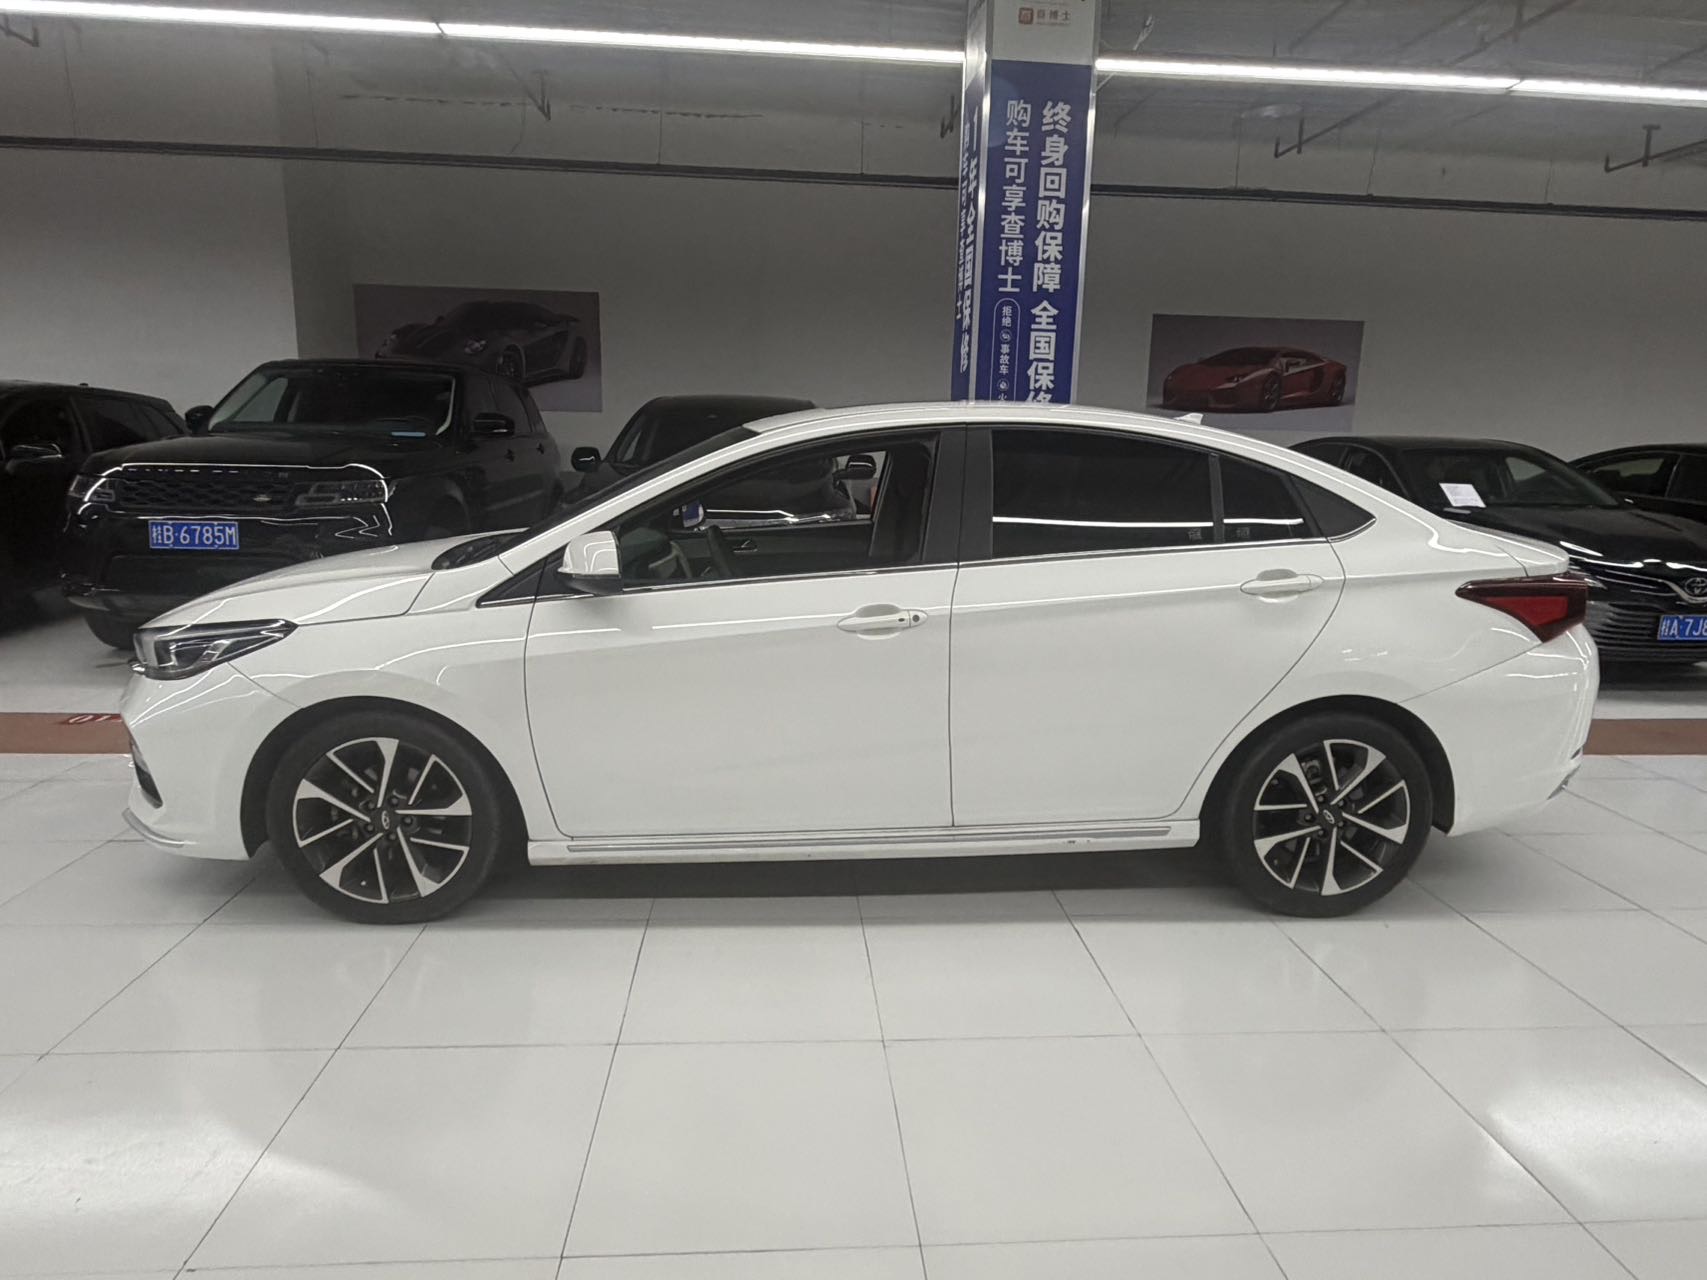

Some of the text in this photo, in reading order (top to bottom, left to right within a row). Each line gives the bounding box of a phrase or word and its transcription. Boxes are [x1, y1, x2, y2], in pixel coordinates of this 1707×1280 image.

[997, 99, 1032, 293] 购车可享查博士
[1032, 101, 1072, 293] 终身回购保障
